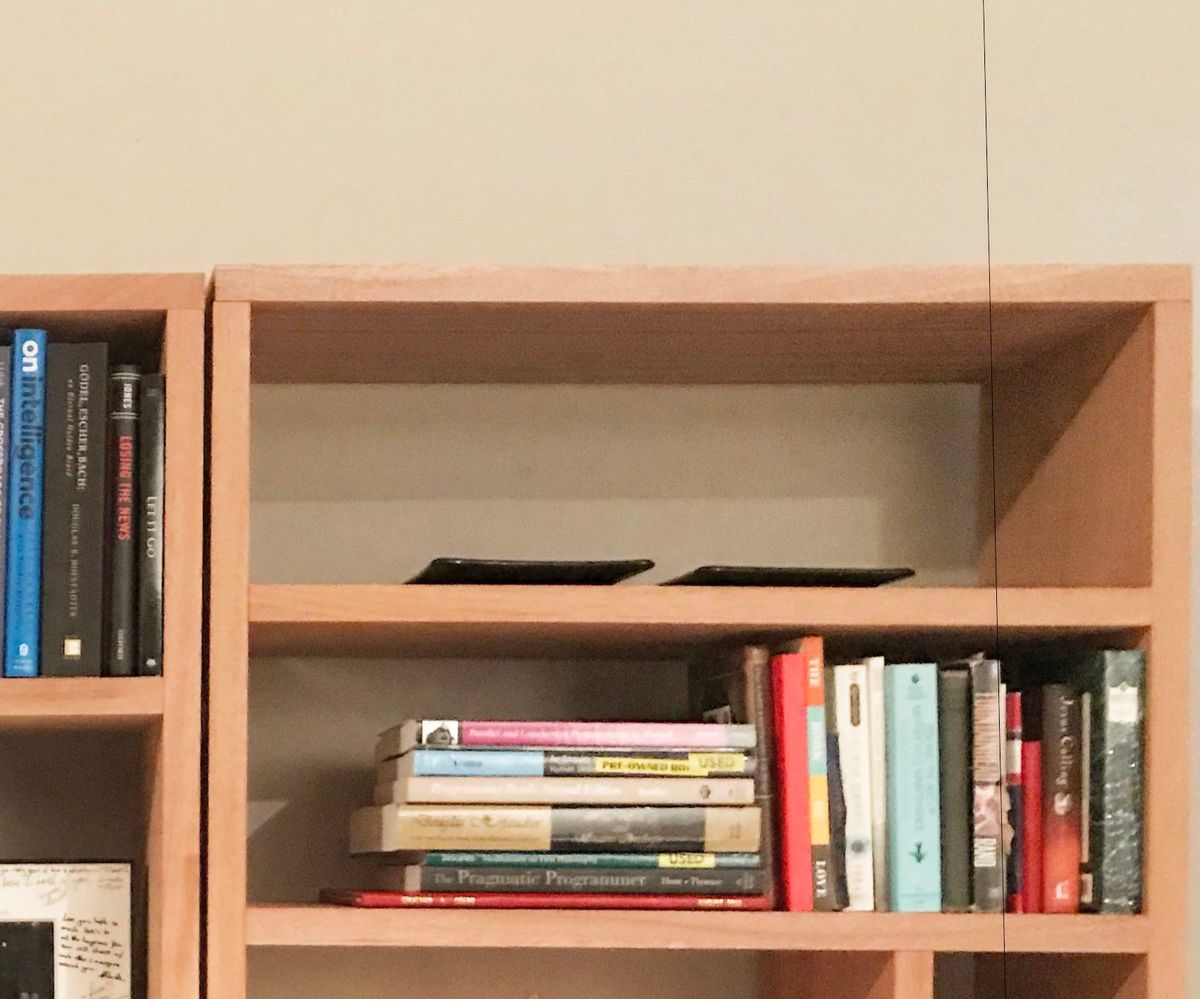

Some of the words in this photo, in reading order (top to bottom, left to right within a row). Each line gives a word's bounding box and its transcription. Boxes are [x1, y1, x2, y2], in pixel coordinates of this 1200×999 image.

[21, 339, 39, 374] on
[15, 375, 44, 521] intelligence
[118, 435, 133, 478] LOSING
[117, 483, 132, 505] THE
[117, 507, 131, 541] NEWS
[699, 757, 736, 769] USED
[1055, 735, 1074, 786] Calling
[433, 873, 450, 884] The
[456, 870, 539, 888] Pragmatic
[544, 871, 647, 889] Programmer
